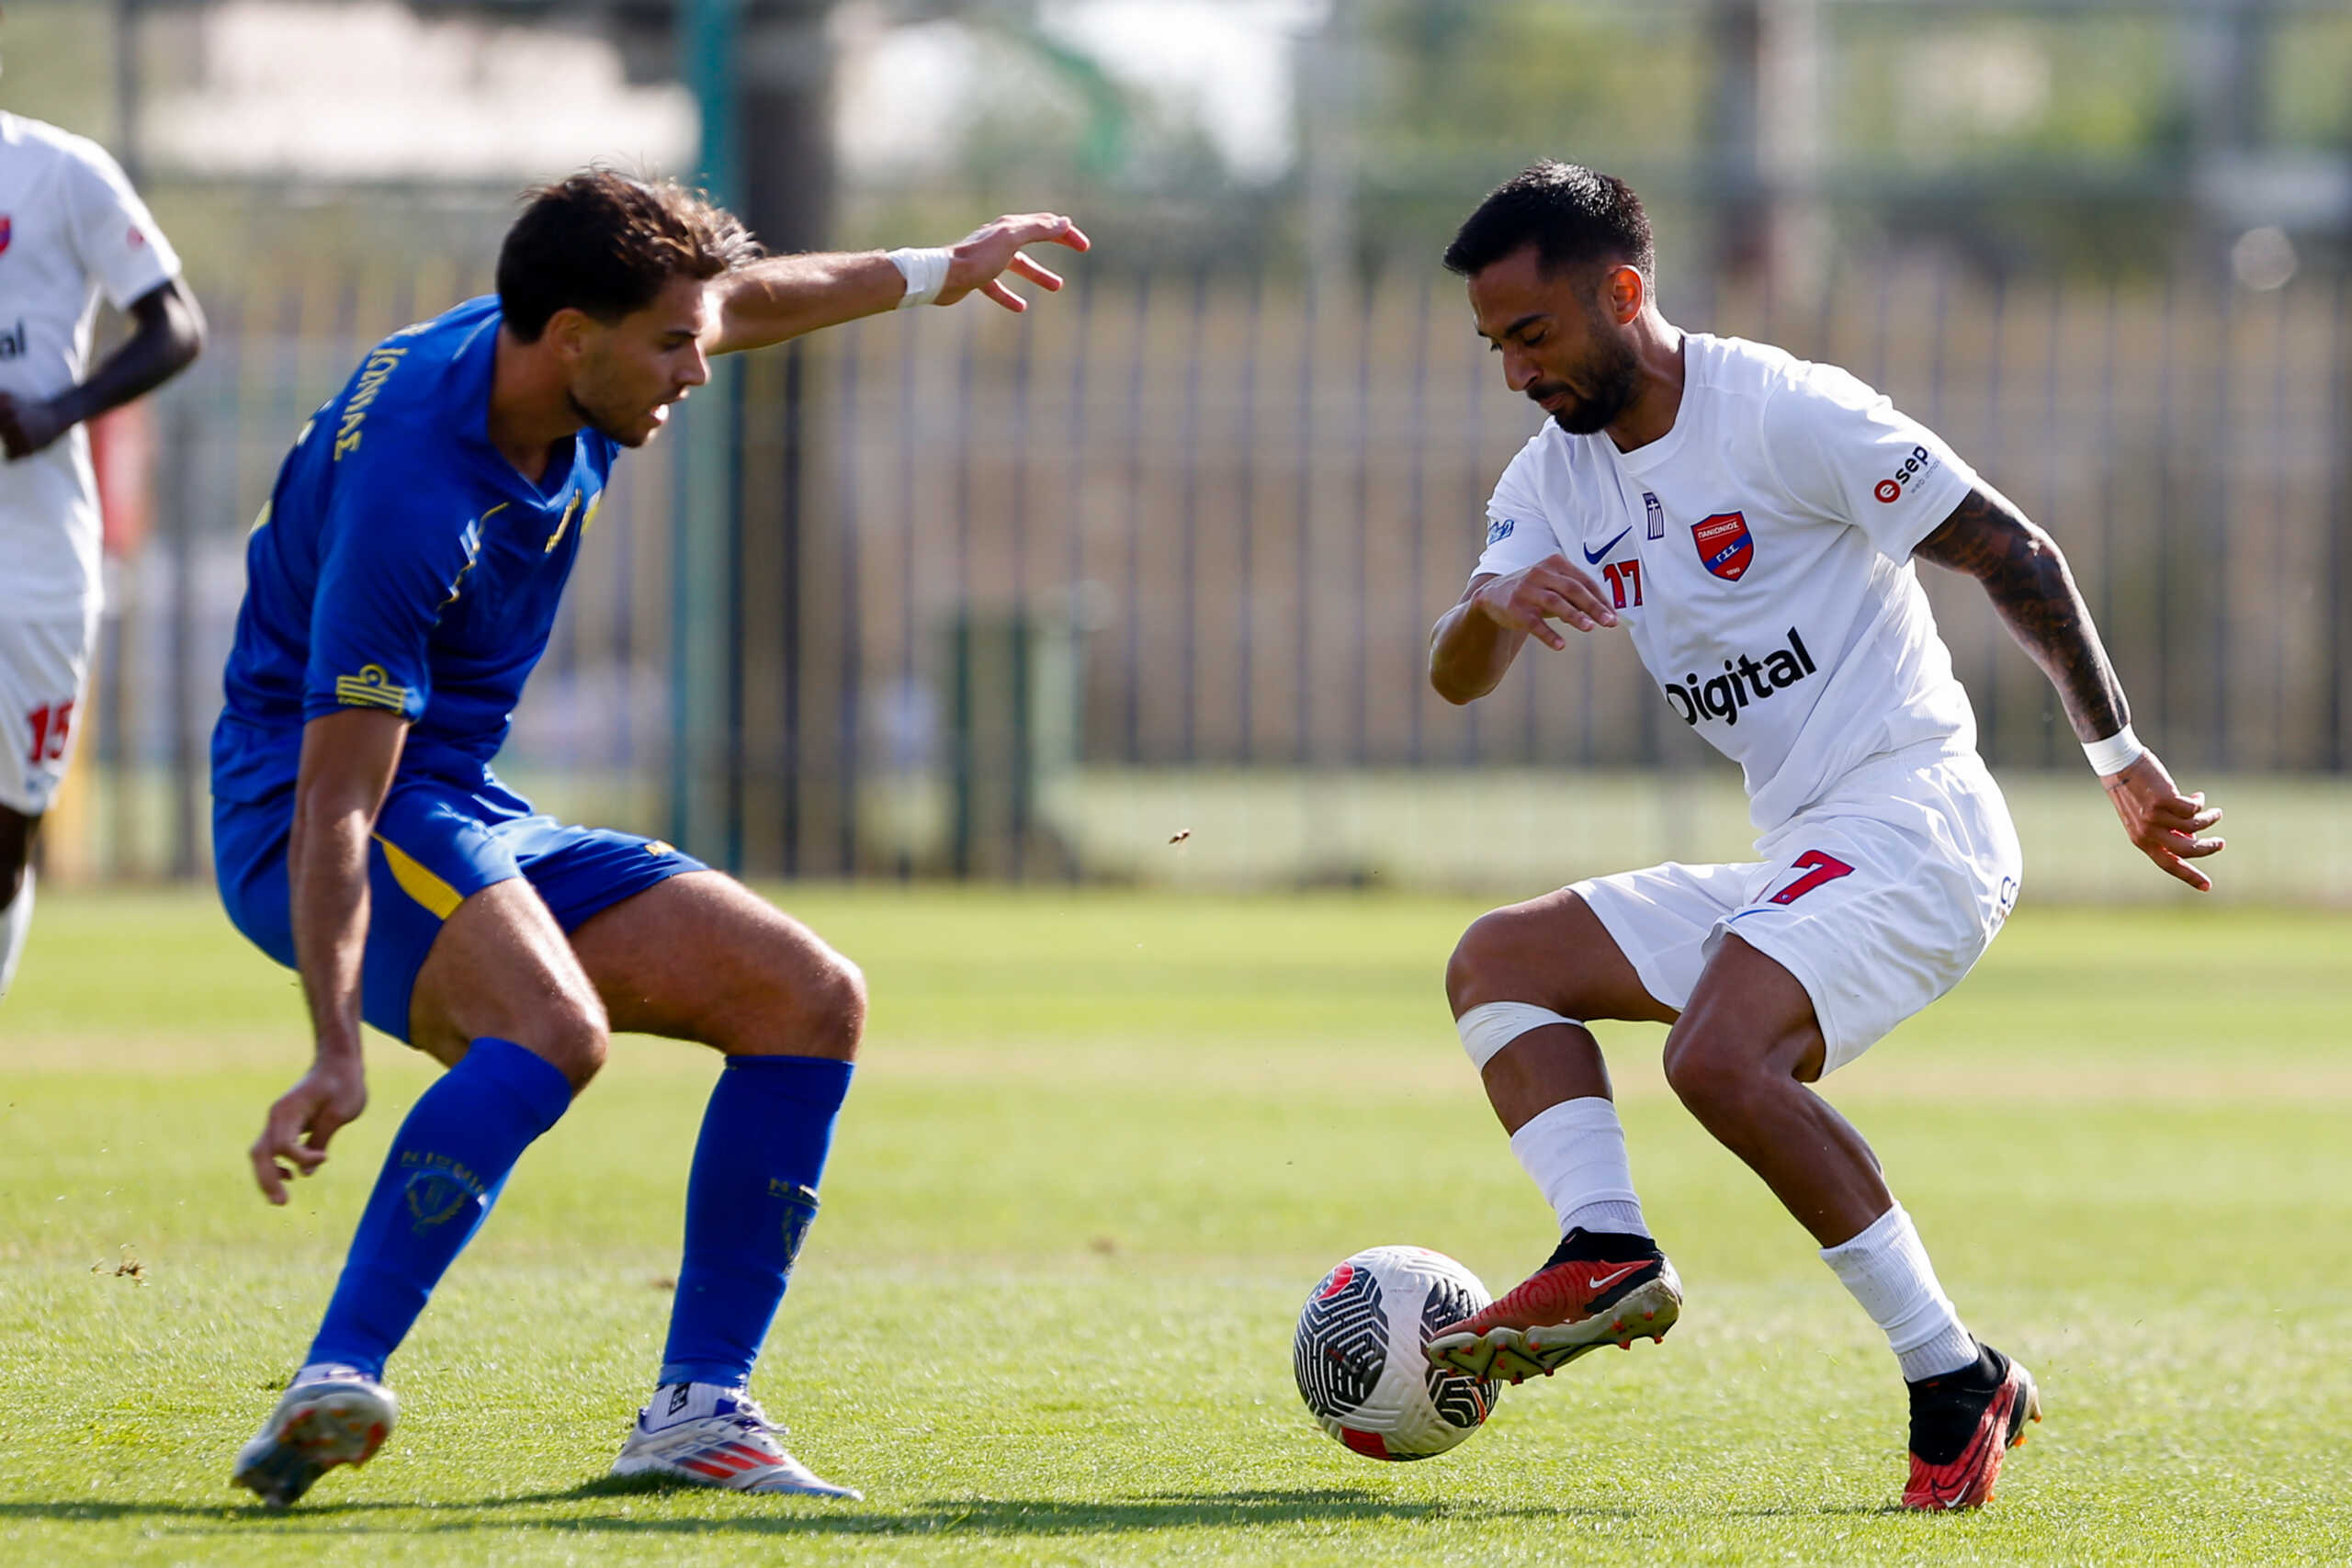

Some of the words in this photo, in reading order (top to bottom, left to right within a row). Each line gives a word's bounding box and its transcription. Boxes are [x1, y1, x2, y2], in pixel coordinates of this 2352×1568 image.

[1602, 558, 1644, 610] 17
[1665, 626, 1817, 727] Digital
[28, 699, 75, 763] 15
[1750, 849, 1856, 906] 7
